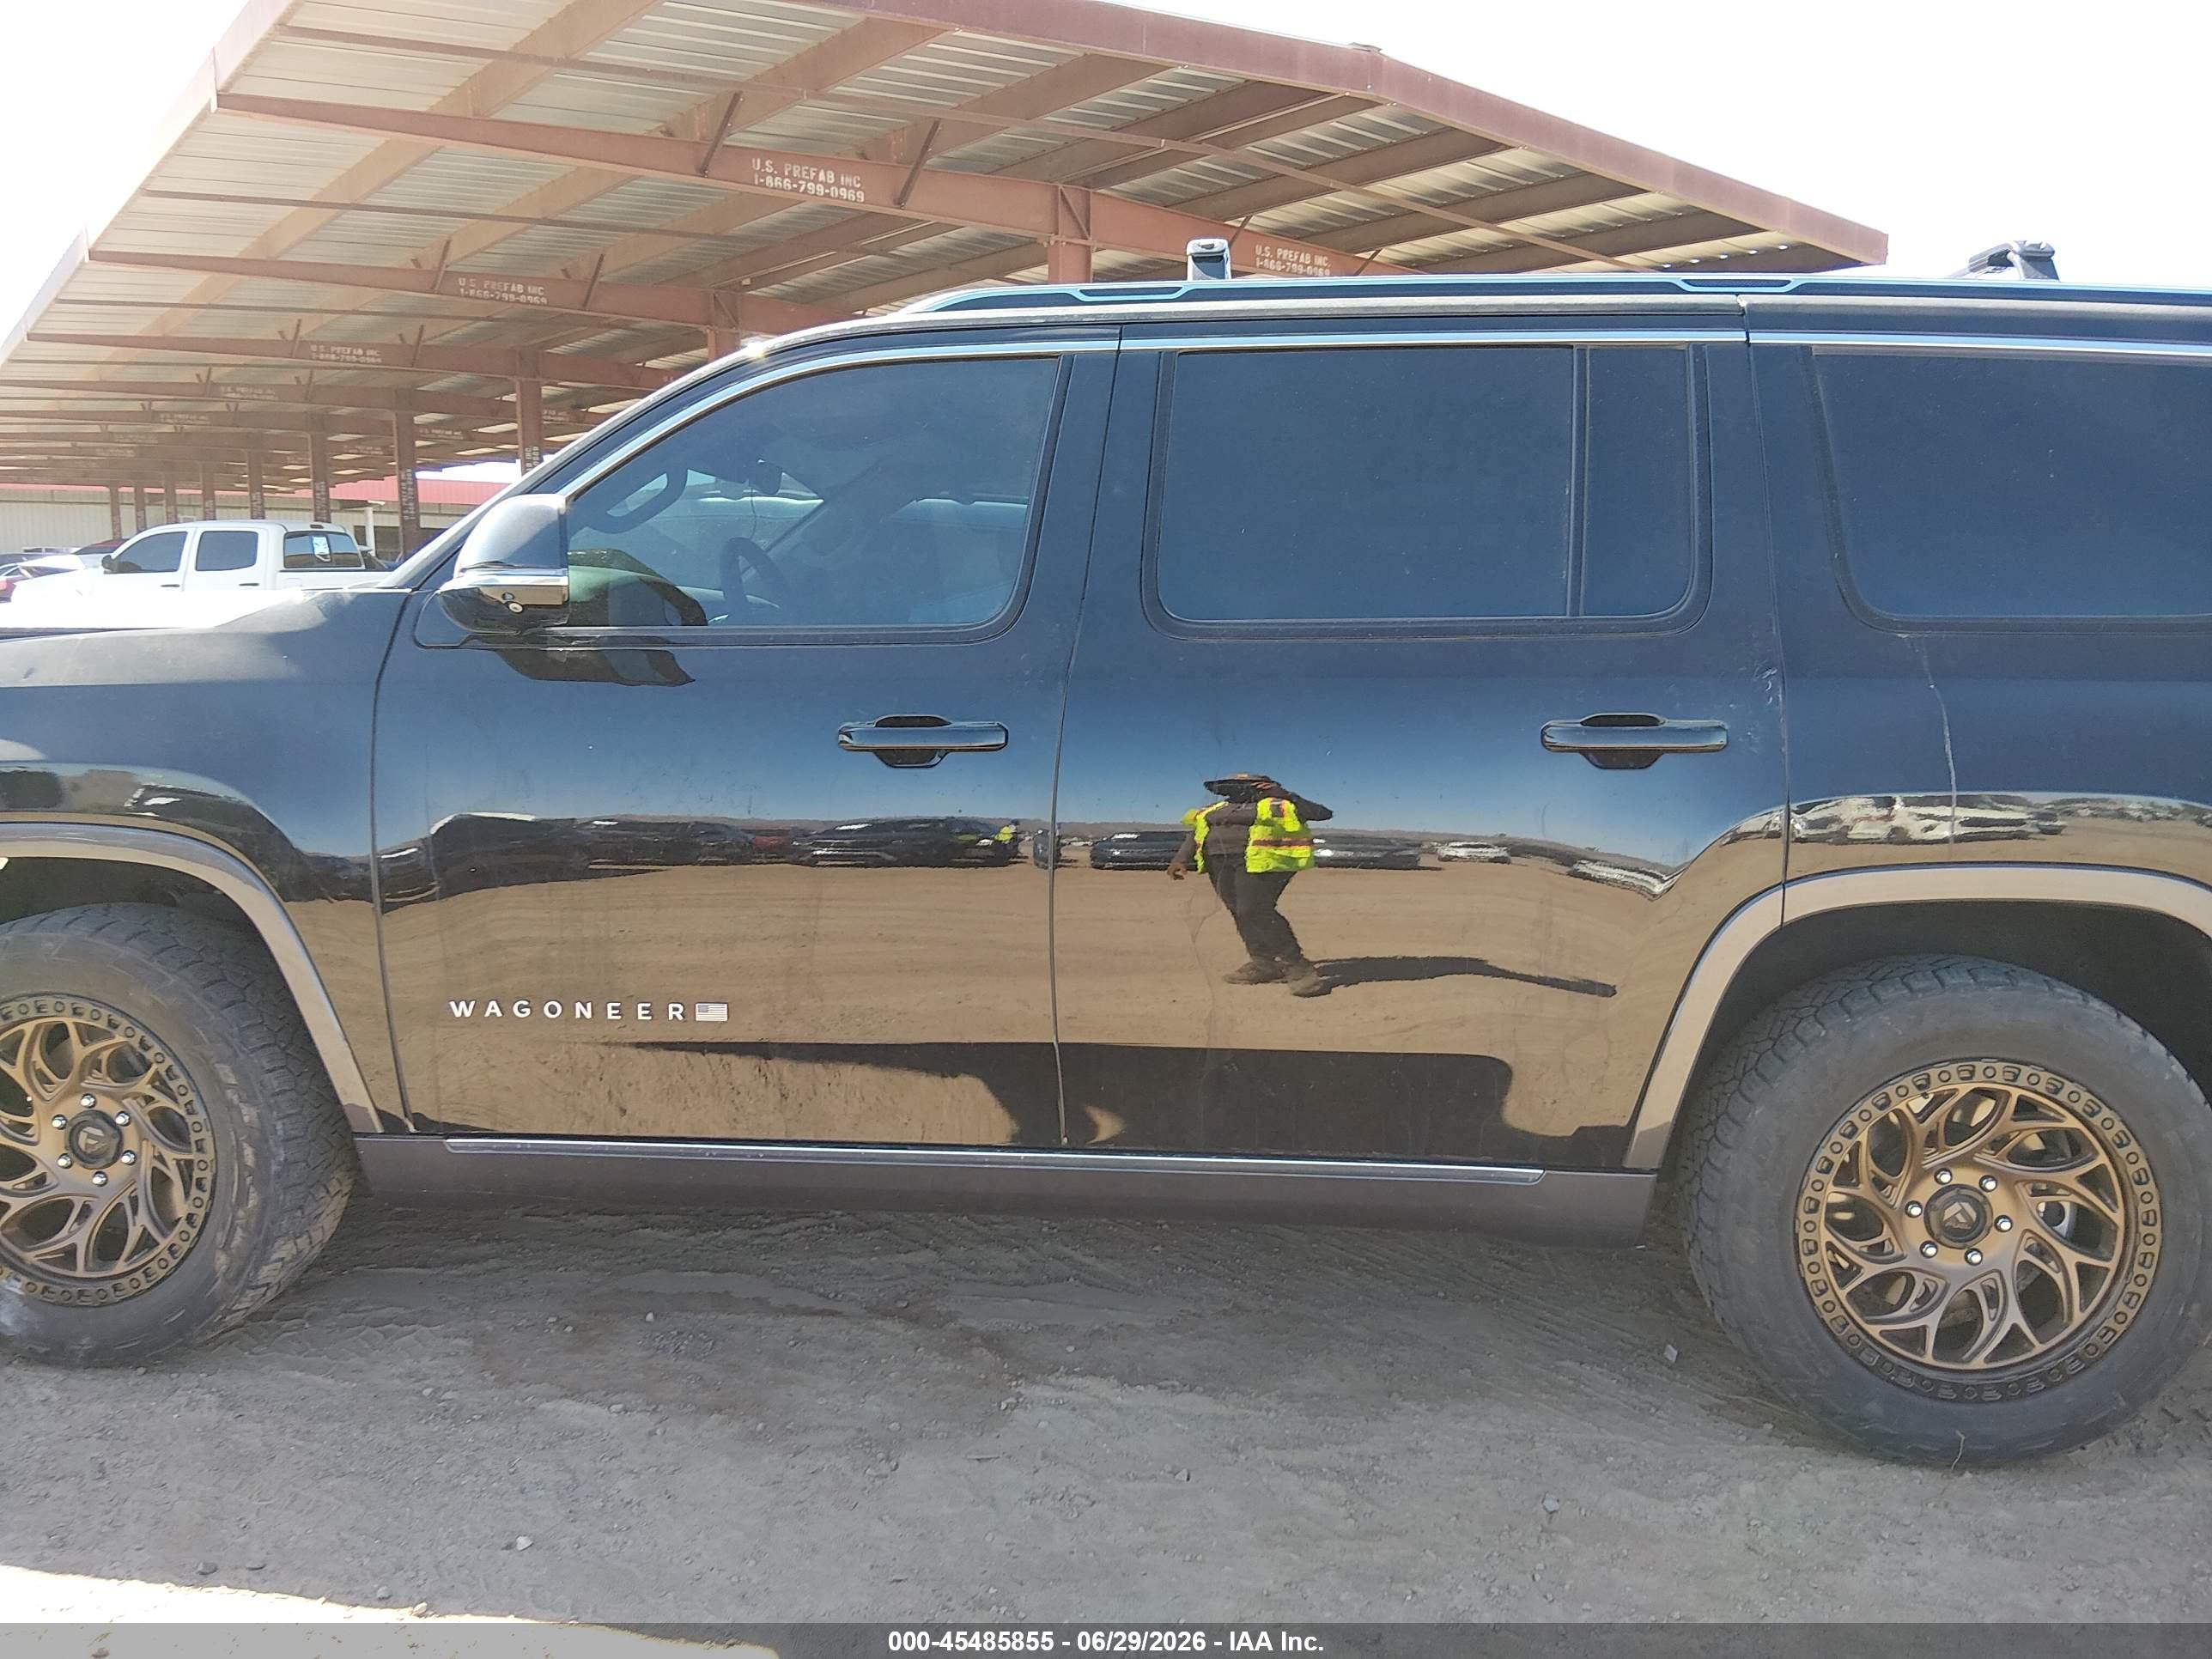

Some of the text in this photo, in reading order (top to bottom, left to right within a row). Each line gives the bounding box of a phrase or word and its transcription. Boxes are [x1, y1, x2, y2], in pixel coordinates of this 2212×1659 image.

[751, 157, 778, 174] U.S.
[784, 163, 836, 184] PREFAB
[754, 173, 866, 203] 1-866-799-0969
[1255, 244, 1273, 258] U.S.
[1277, 247, 1312, 264] PREFAB
[483, 280, 524, 294] PREFAB
[448, 1000, 686, 1022] WAGONEER
